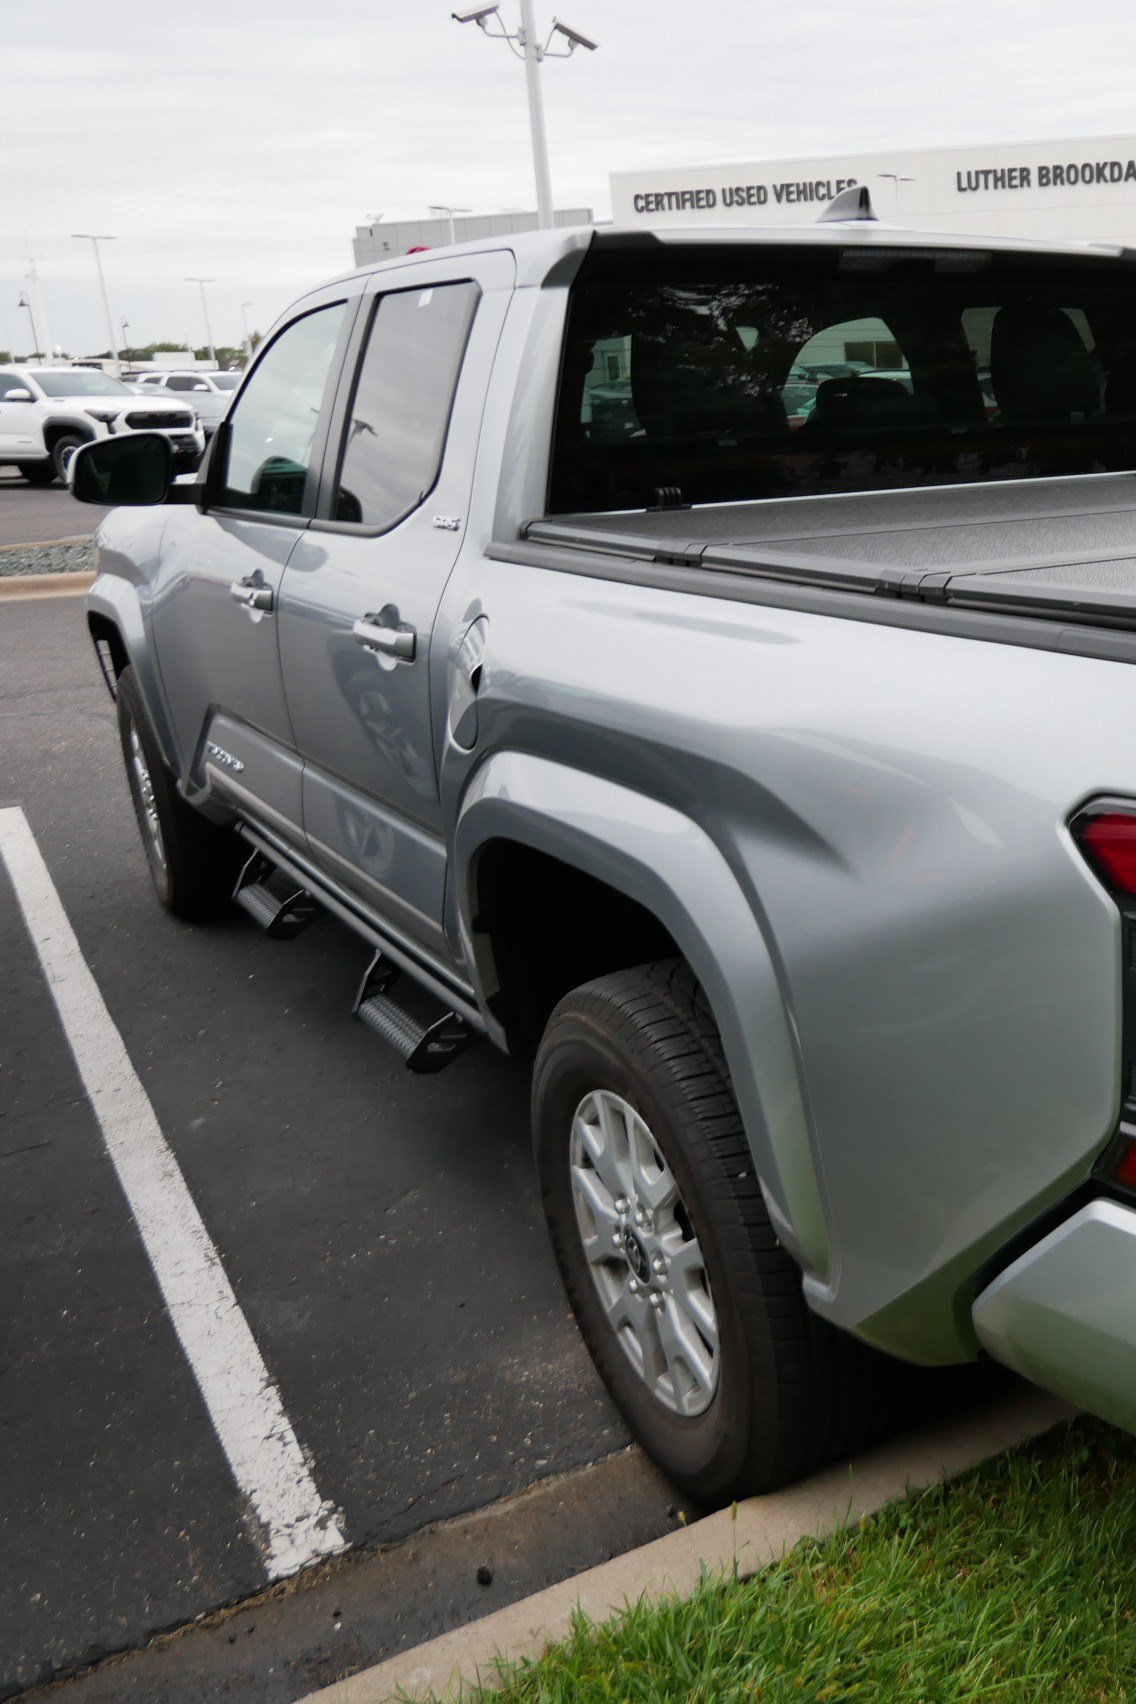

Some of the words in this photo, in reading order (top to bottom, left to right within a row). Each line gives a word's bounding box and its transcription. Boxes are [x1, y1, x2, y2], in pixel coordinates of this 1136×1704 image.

[956, 167, 1031, 192] LUTHER
[633, 189, 717, 213] CERTIFIED
[721, 186, 769, 207] USED
[432, 514, 460, 531] SR5
